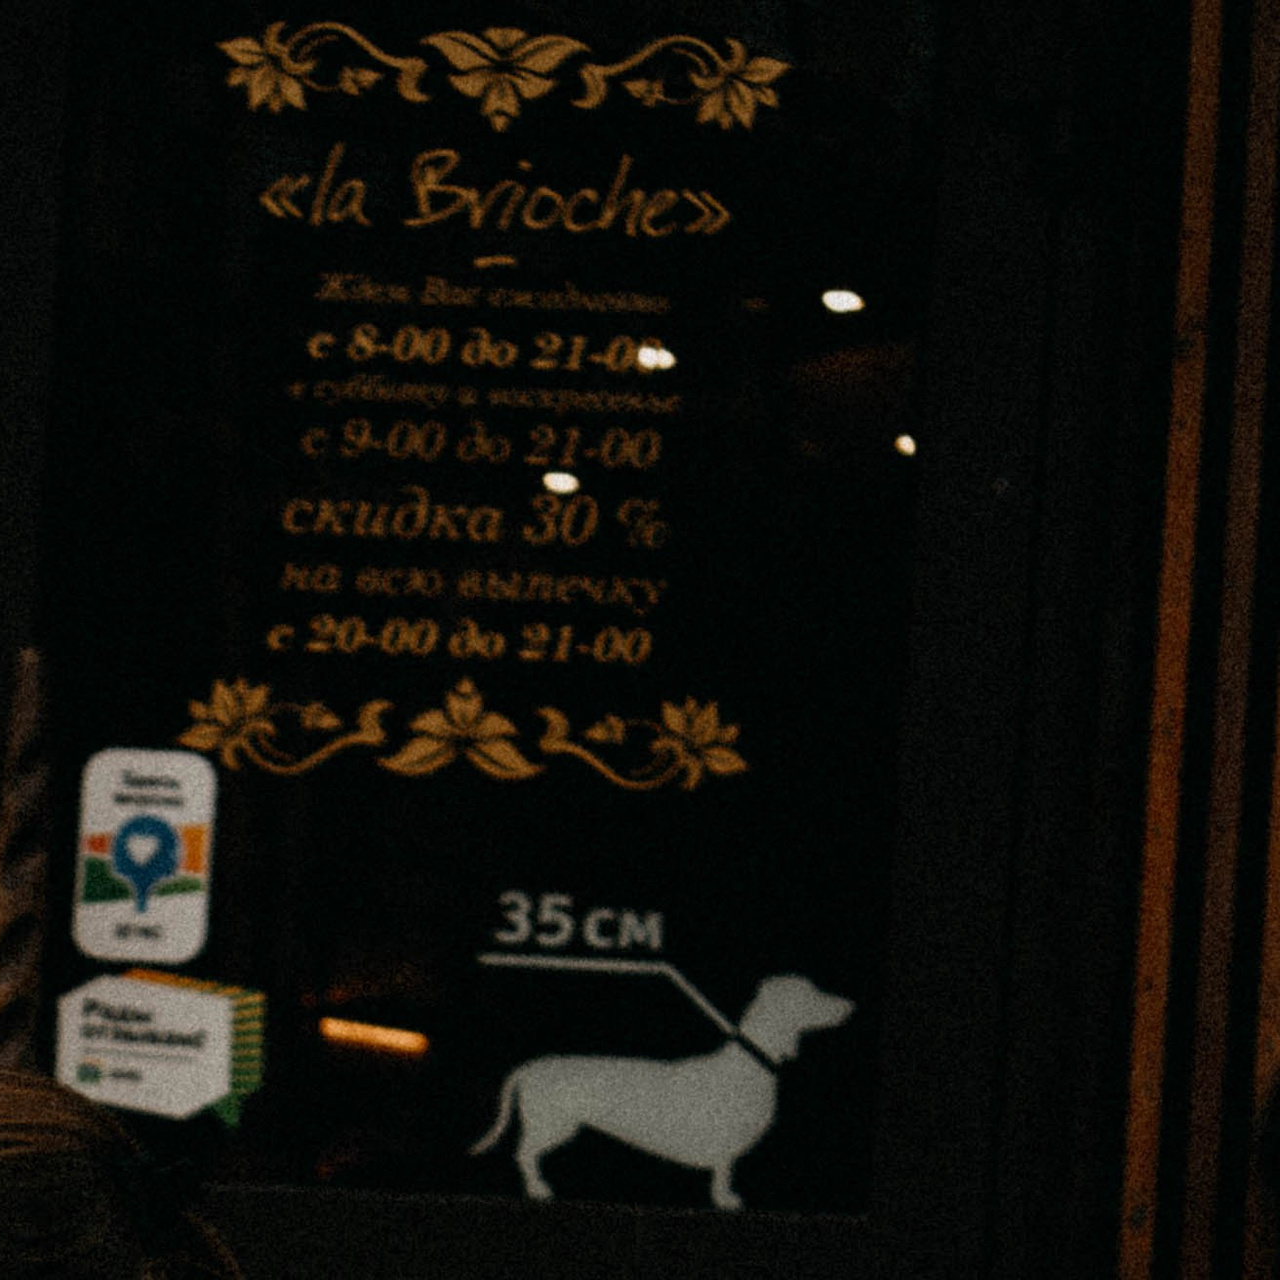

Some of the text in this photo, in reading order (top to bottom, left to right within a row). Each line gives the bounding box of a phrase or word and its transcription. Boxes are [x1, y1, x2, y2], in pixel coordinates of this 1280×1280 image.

[346, 323, 451, 364] 8-00
[460, 327, 518, 368] до
[340, 418, 446, 461] 9-00
[455, 419, 513, 463] до
[524, 424, 662, 469] 21-00
[282, 486, 504, 542] скидка
[523, 495, 599, 545] 30
[305, 614, 439, 655] 20-00
[448, 618, 507, 658] до
[518, 622, 653, 664] 21-00
